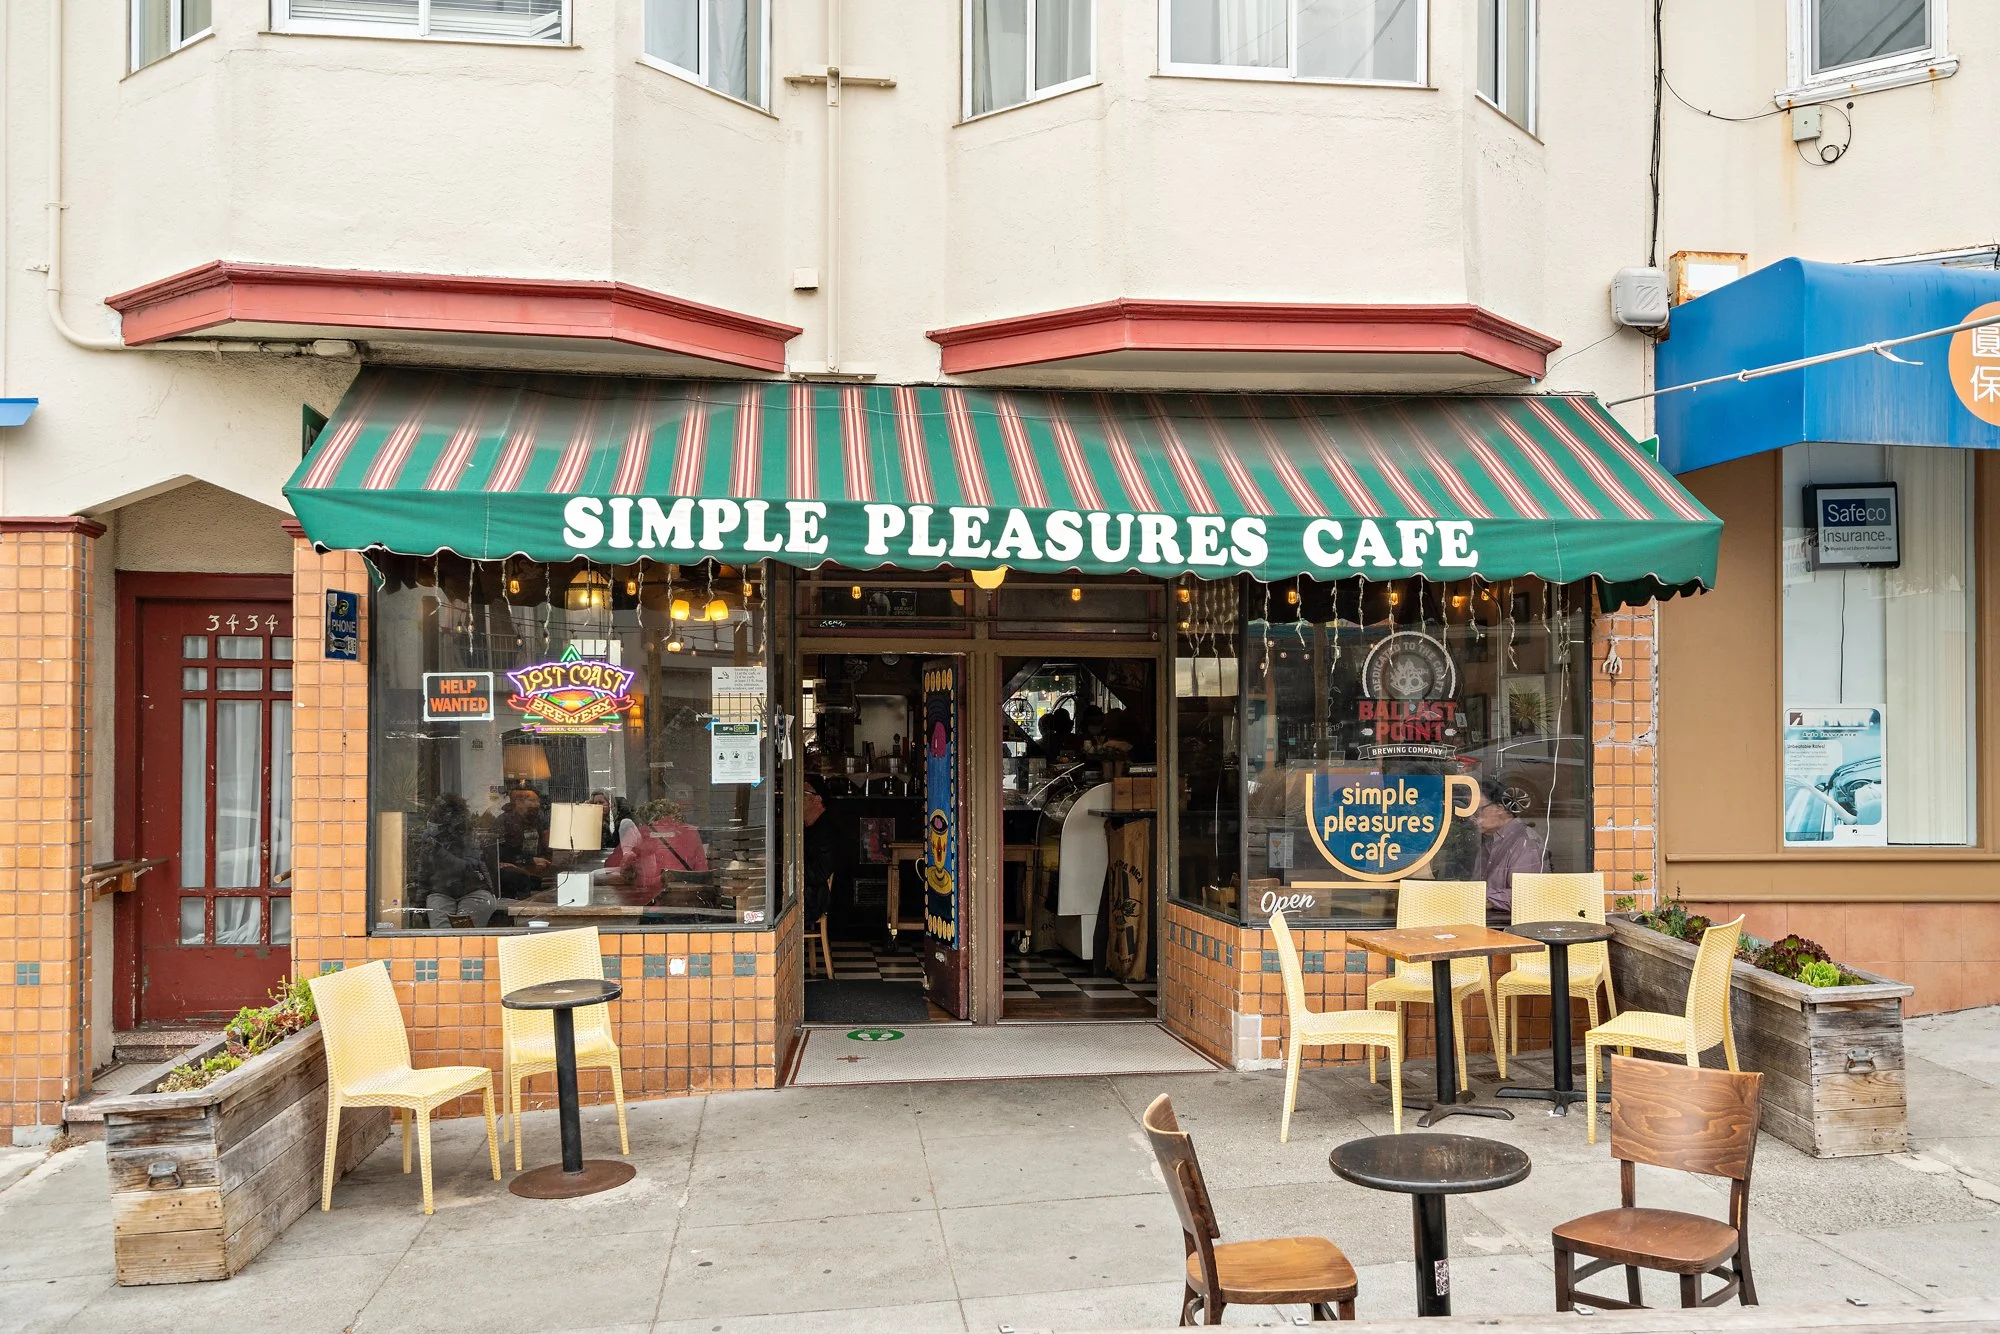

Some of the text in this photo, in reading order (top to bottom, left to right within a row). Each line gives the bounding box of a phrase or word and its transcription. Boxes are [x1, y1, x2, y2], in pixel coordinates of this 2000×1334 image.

[1827, 503, 1887, 523] Safeco
[562, 496, 1479, 568] SIMPLE PLEASURES CAFE
[1823, 529, 1885, 543] Insurance
[206, 613, 279, 635] 3434
[1372, 643, 1401, 692] DEDICATED
[1403, 641, 1416, 651] TO
[1418, 644, 1436, 660] THE
[440, 679, 477, 694] HELP
[517, 664, 626, 696] LOST COAST
[430, 697, 488, 713] WANTED
[530, 697, 612, 724] BREWERY
[1358, 700, 1457, 721] BALLAST
[1375, 721, 1446, 742] POINT
[1372, 746, 1443, 756] BREWING COMPANY
[1341, 778, 1419, 814] simple
[1324, 806, 1435, 841] pleasures
[1350, 833, 1401, 868] cafe
[1260, 891, 1316, 915] Open
